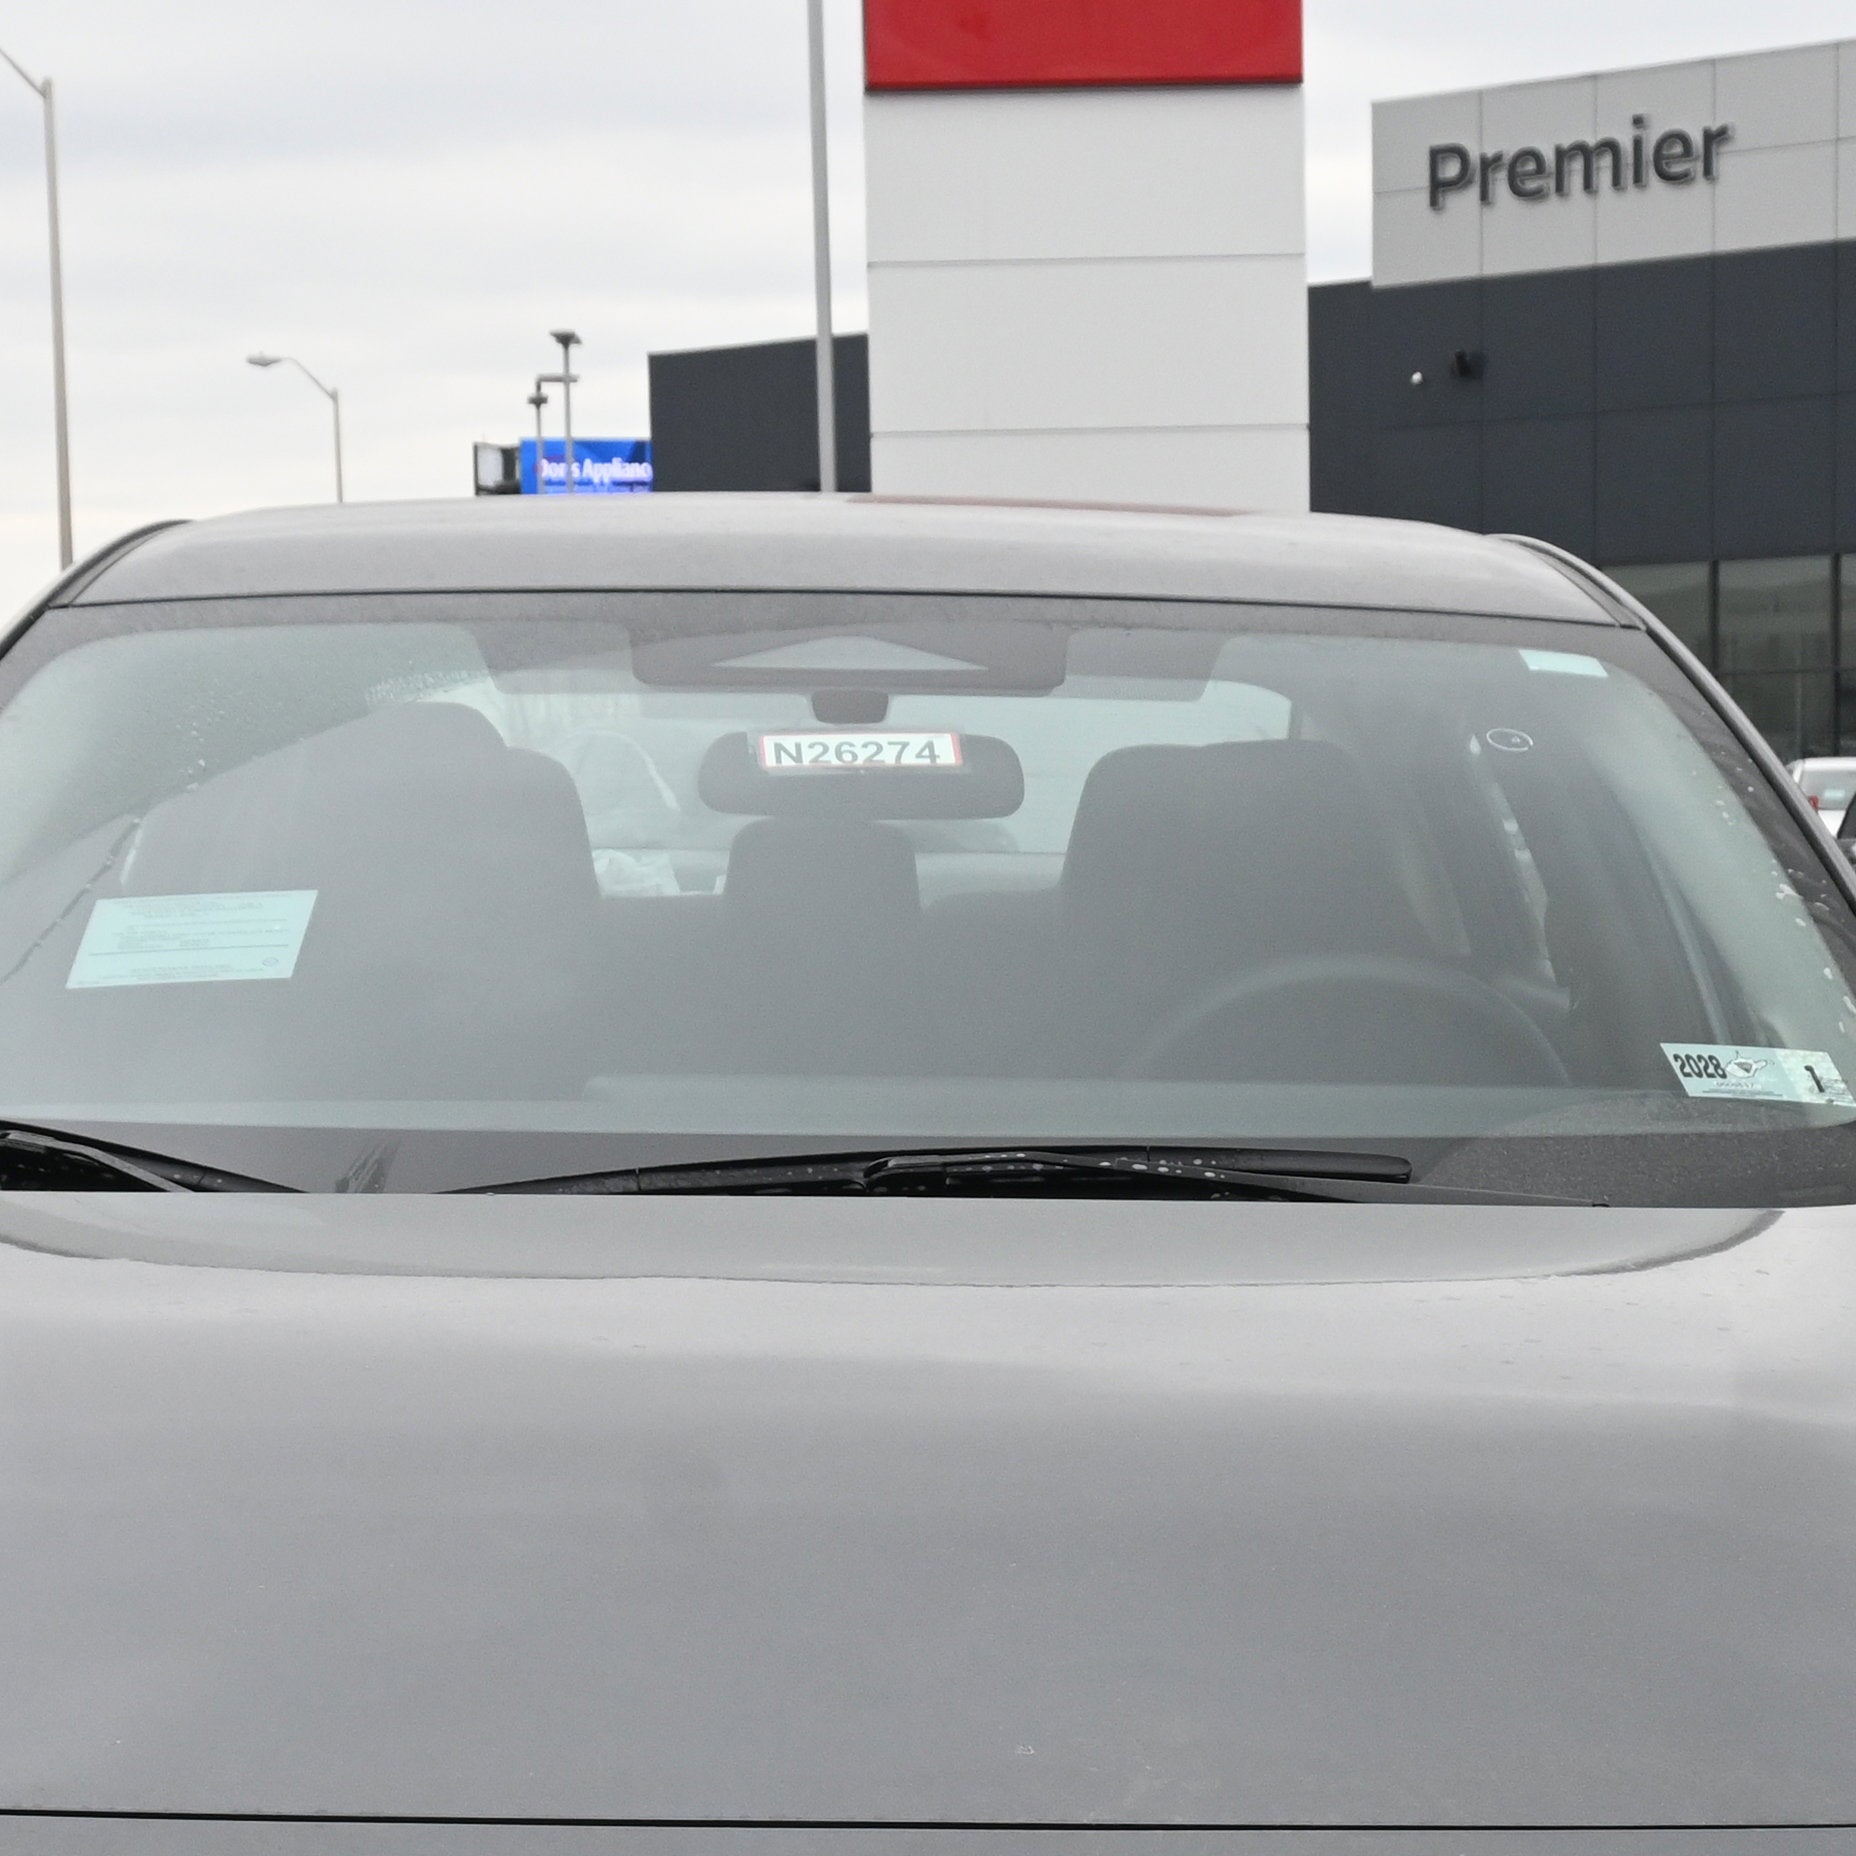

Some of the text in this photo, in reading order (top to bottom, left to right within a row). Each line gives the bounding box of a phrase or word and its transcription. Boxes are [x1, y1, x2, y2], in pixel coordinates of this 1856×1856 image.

[1429, 113, 1734, 210] Premier
[540, 458, 580, 478] Dons
[773, 740, 940, 764] N26274
[1673, 1053, 1728, 1079] 2028
[1804, 1065, 1826, 1093] 1
